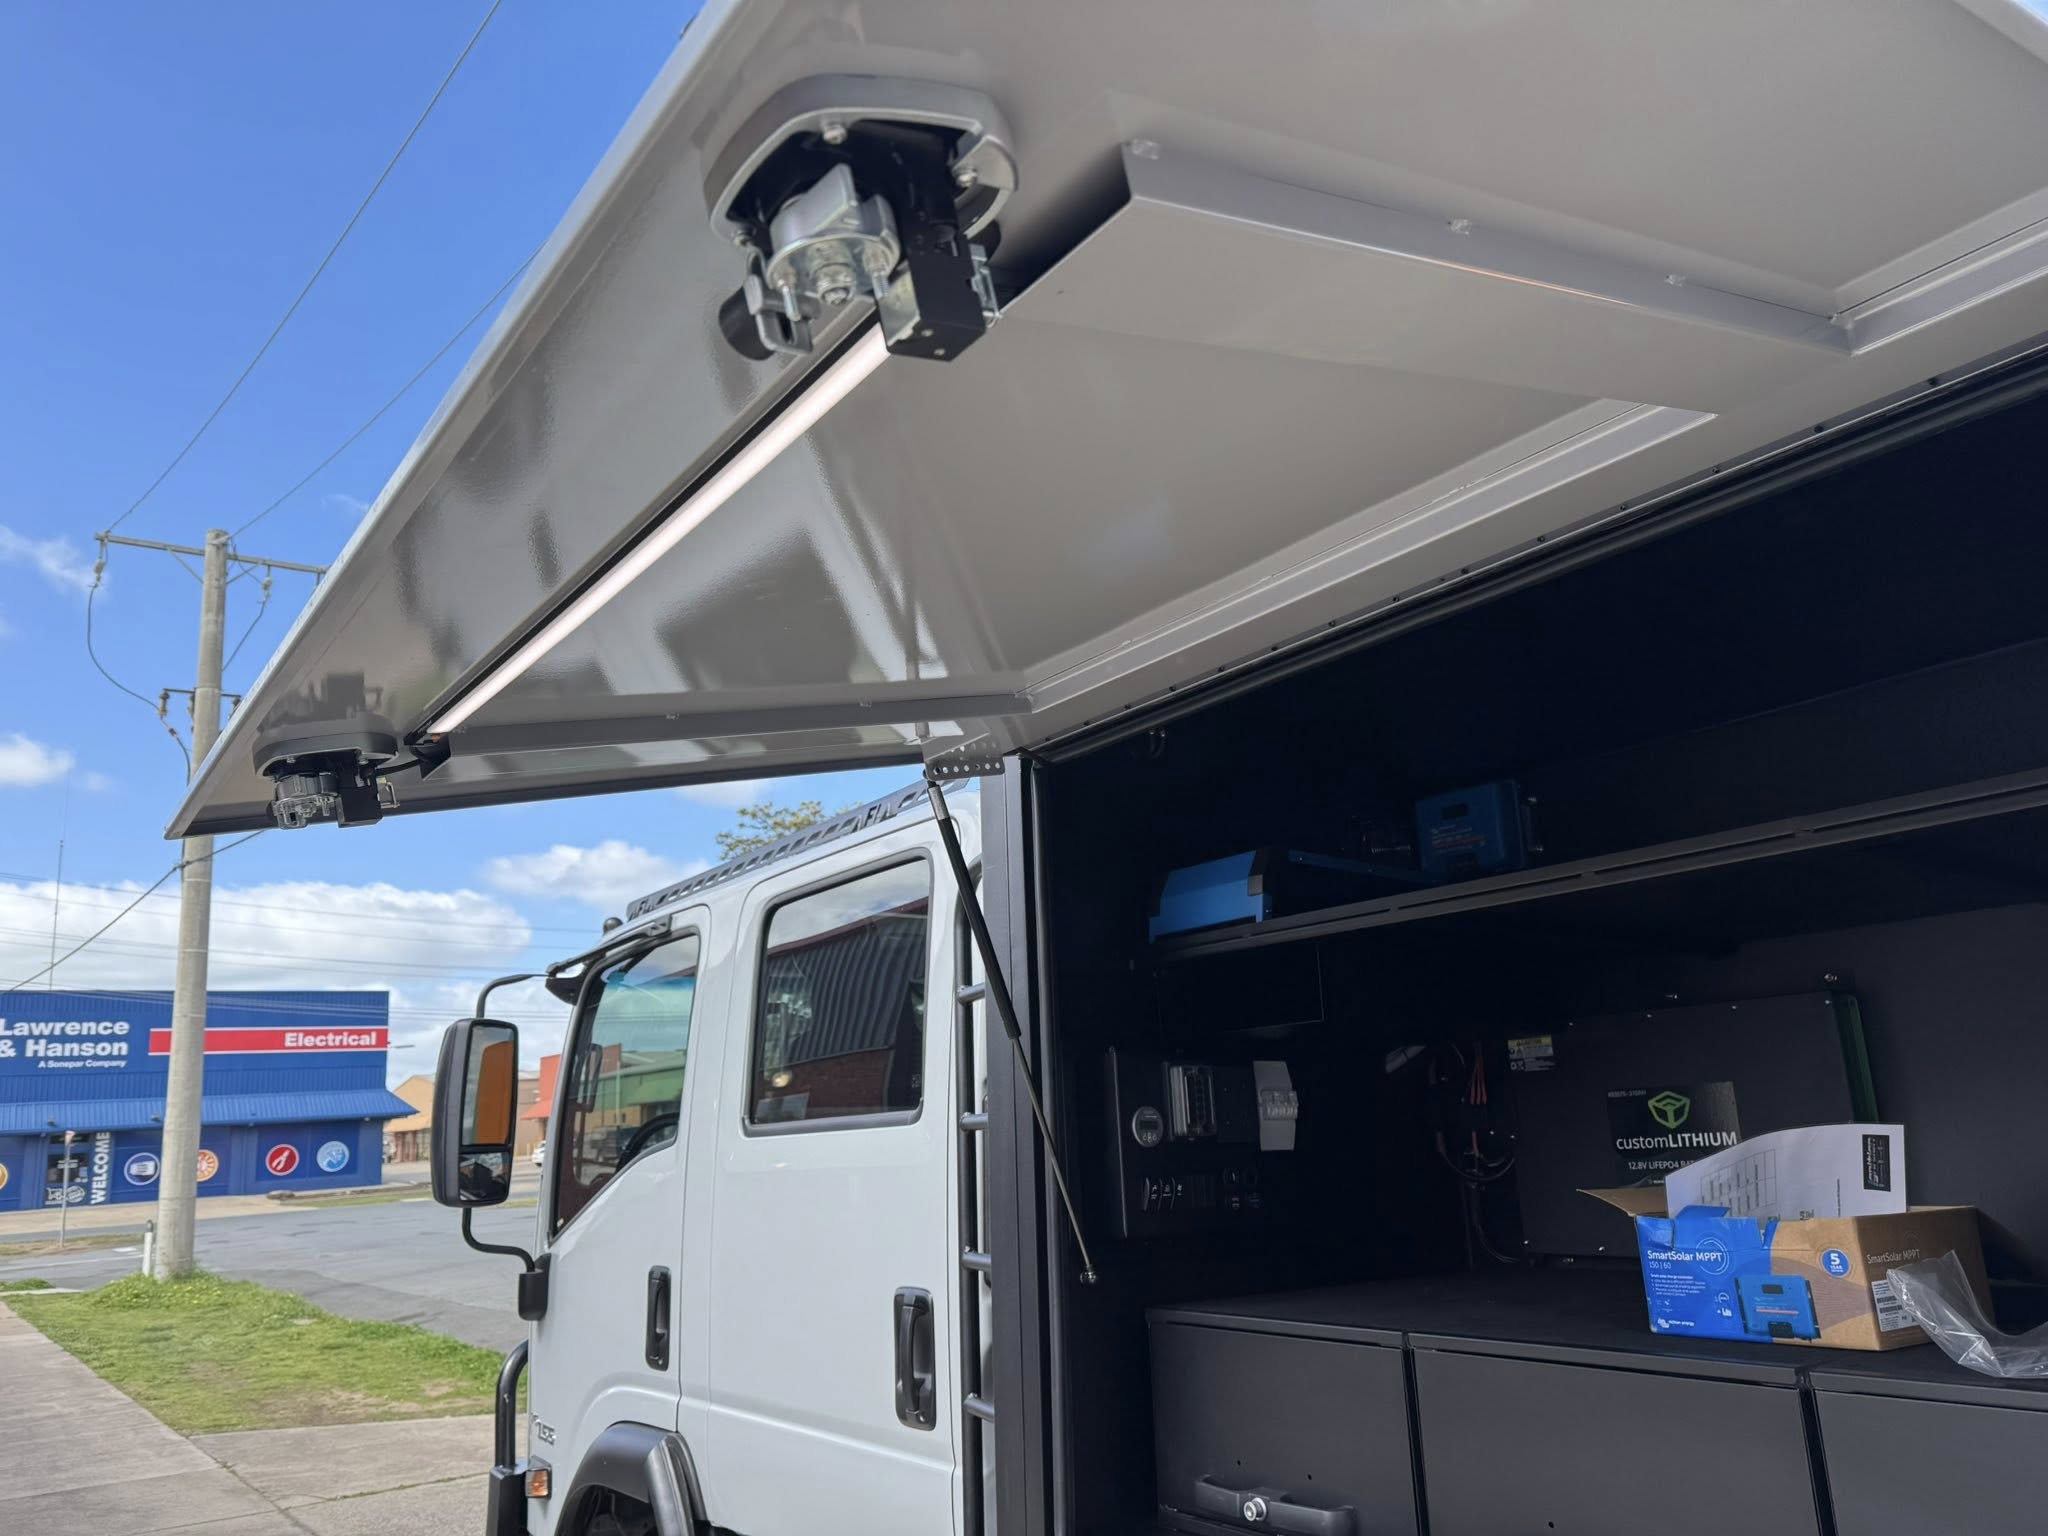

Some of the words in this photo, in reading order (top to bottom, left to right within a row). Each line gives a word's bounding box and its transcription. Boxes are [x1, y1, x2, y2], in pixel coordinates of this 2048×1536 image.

[0, 1018, 130, 1036] Lawrence
[284, 1032, 377, 1047] Electrical
[0, 1039, 17, 1057] &
[25, 1039, 129, 1057] Hanson
[85, 1060, 128, 1069] Company
[1616, 1131, 1738, 1150] customLITHIUM
[90, 1131, 111, 1204] WELCOME
[1647, 1250, 1693, 1261] SmartSolar
[1696, 1251, 1722, 1262] MPPT
[1830, 1253, 1840, 1265] 5
